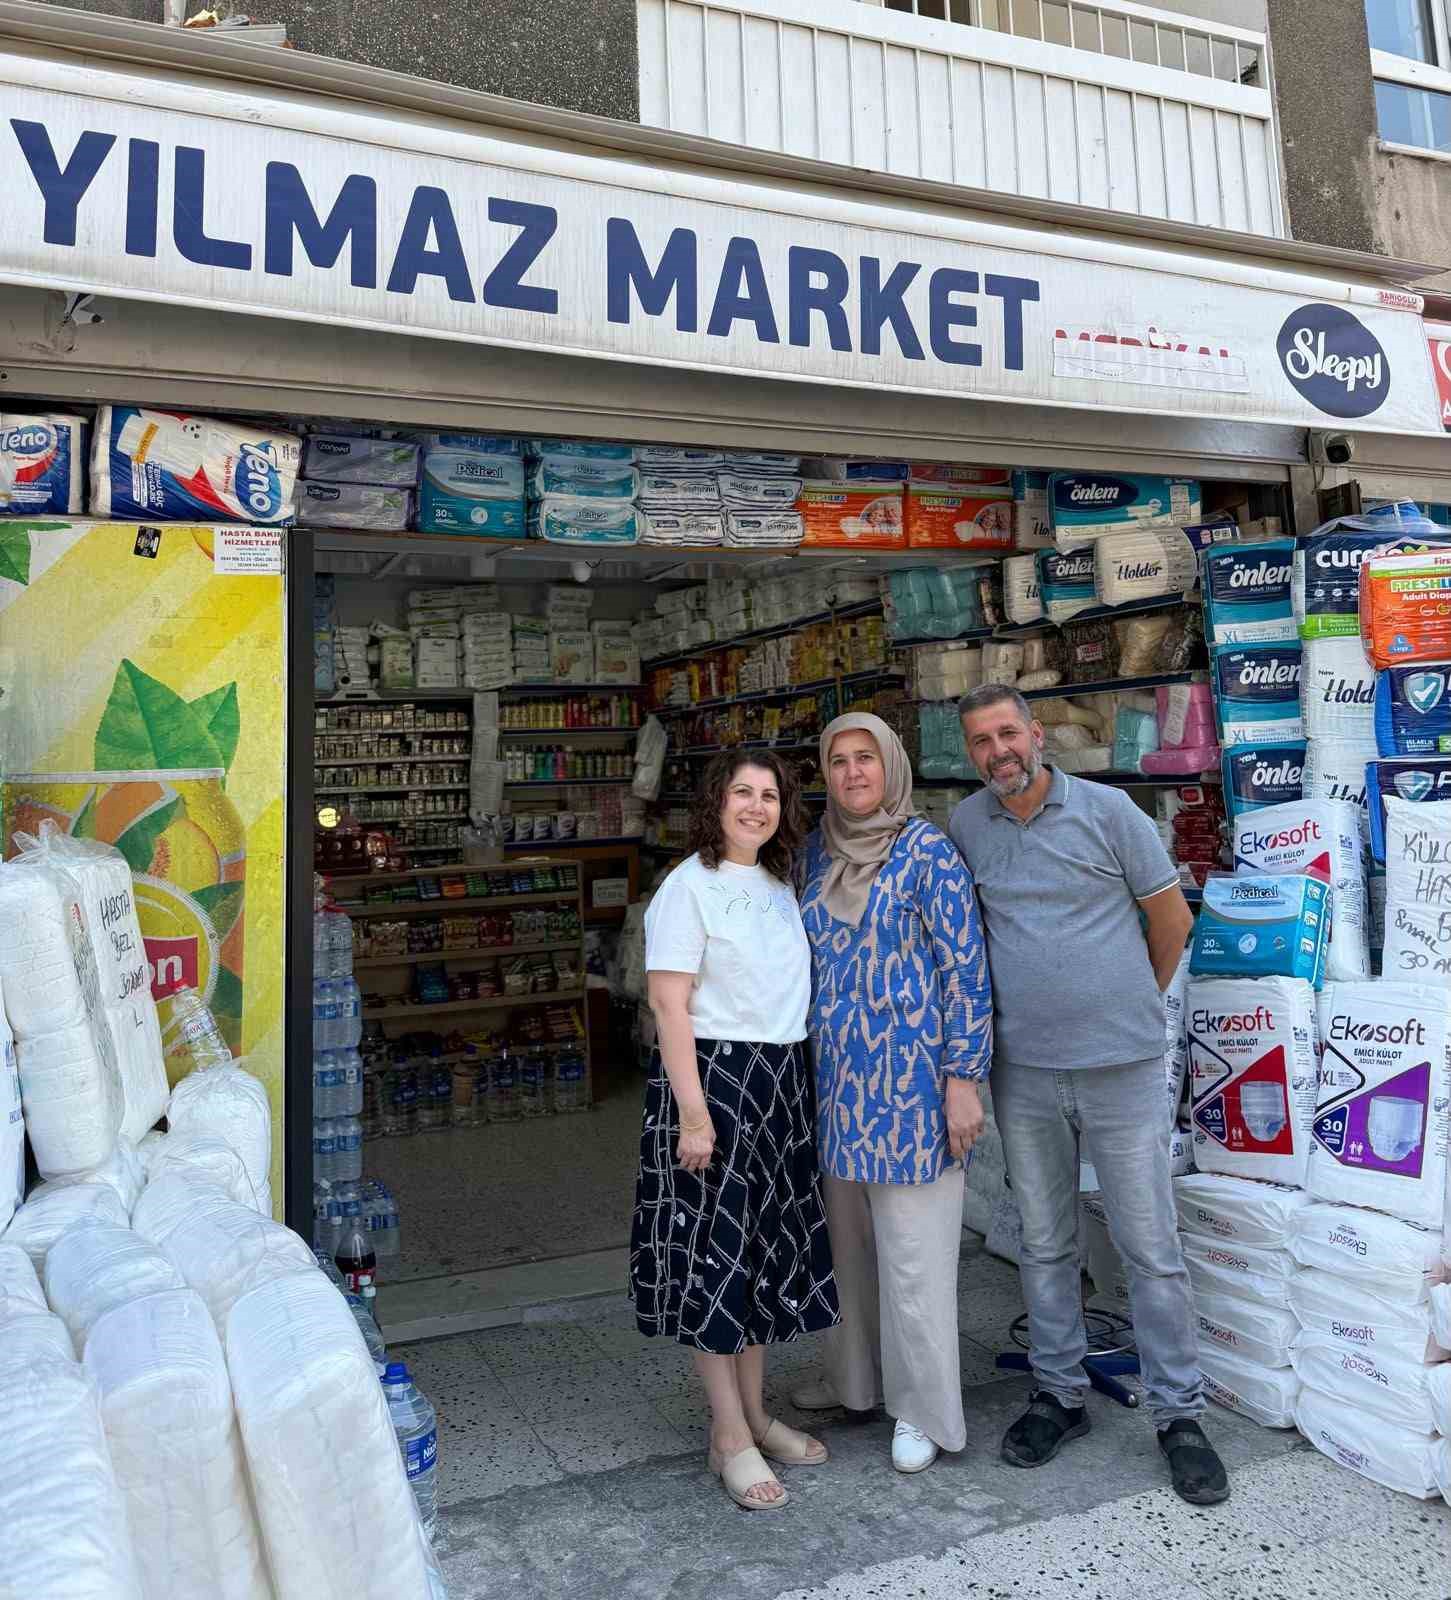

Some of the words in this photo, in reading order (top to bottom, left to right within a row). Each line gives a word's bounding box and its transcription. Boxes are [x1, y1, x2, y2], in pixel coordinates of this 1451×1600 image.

[10, 118, 558, 314] YILMAZ
[607, 217, 1040, 370] MARKET
[1286, 327, 1381, 392] Sleepy
[239, 441, 279, 512] Teno
[456, 462, 503, 478] Pedical
[1070, 482, 1120, 501] önlem
[434, 508, 447, 518] 30
[1117, 562, 1163, 581] Holder
[1402, 592, 1427, 601] Adult
[1251, 760, 1301, 786] önle
[1240, 819, 1322, 855] Ekosoft
[1231, 885, 1279, 899] Pedical
[1203, 938, 1216, 948] 30
[1400, 950, 1429, 970] 30
[1192, 1006, 1275, 1033] Ekosoft
[1330, 1015, 1426, 1046] Ekosoft
[1359, 1057, 1375, 1065] ADULT
[1376, 1047, 1403, 1060] KÜLOT
[1204, 1108, 1221, 1120] 30
[1322, 1118, 1343, 1132] 30
[1331, 1320, 1376, 1341] Ekosoft
